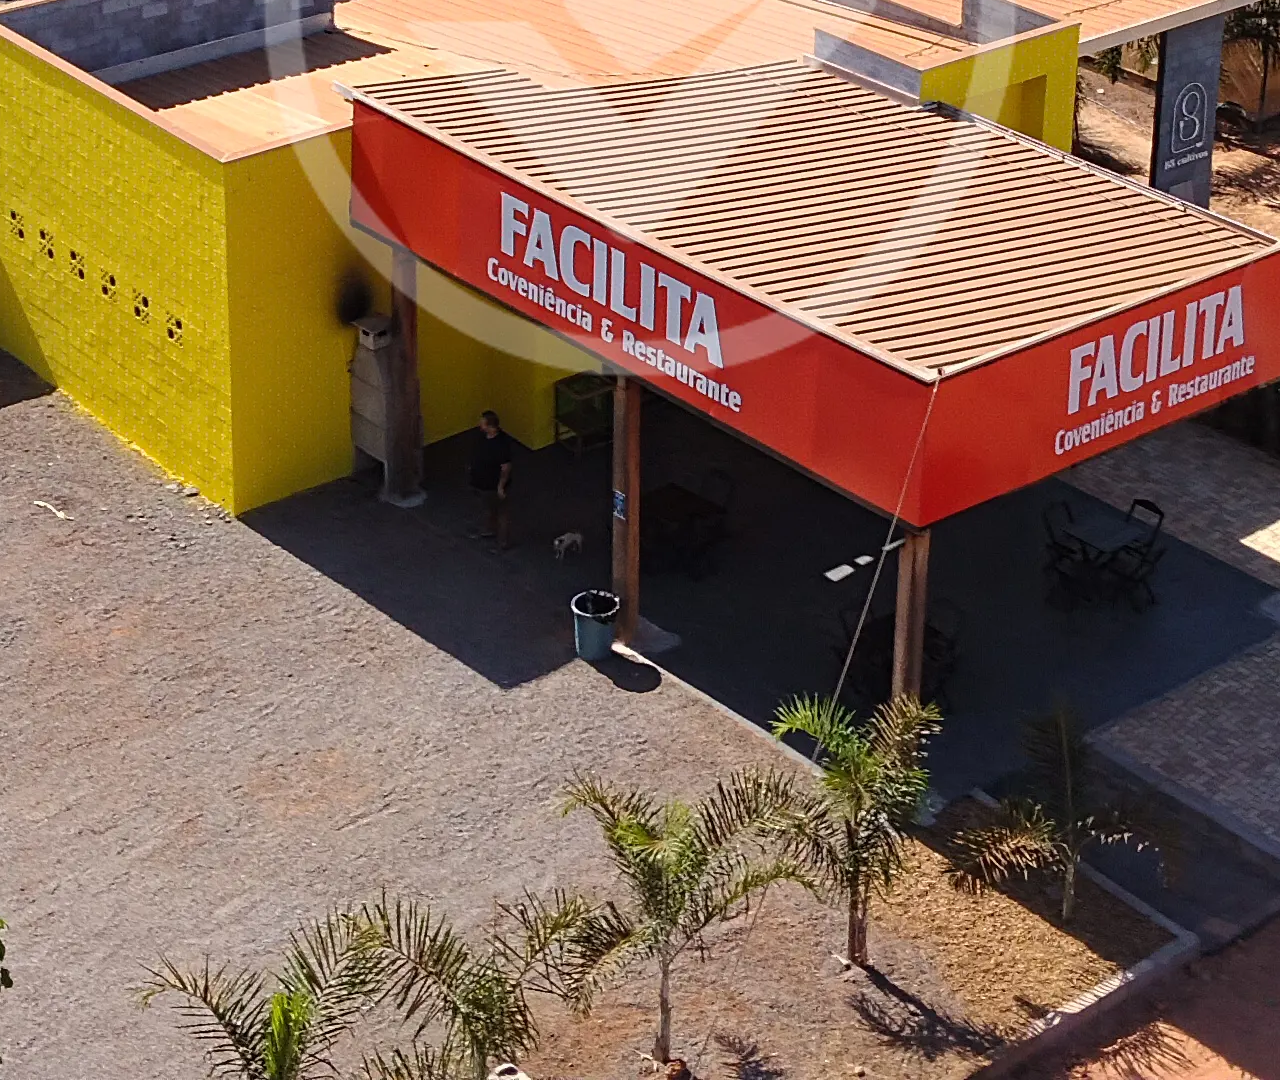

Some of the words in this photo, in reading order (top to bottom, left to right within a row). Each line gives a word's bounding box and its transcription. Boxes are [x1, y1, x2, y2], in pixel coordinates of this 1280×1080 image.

[487, 257, 593, 332] Coveniência
[601, 317, 613, 343] &
[622, 329, 742, 413] Restaurante
[500, 191, 724, 369] FACILITA
[1067, 284, 1245, 415] FACILITA
[1054, 399, 1145, 455] Coveniência
[1151, 390, 1162, 414] &
[1168, 355, 1255, 408] Restaurante
